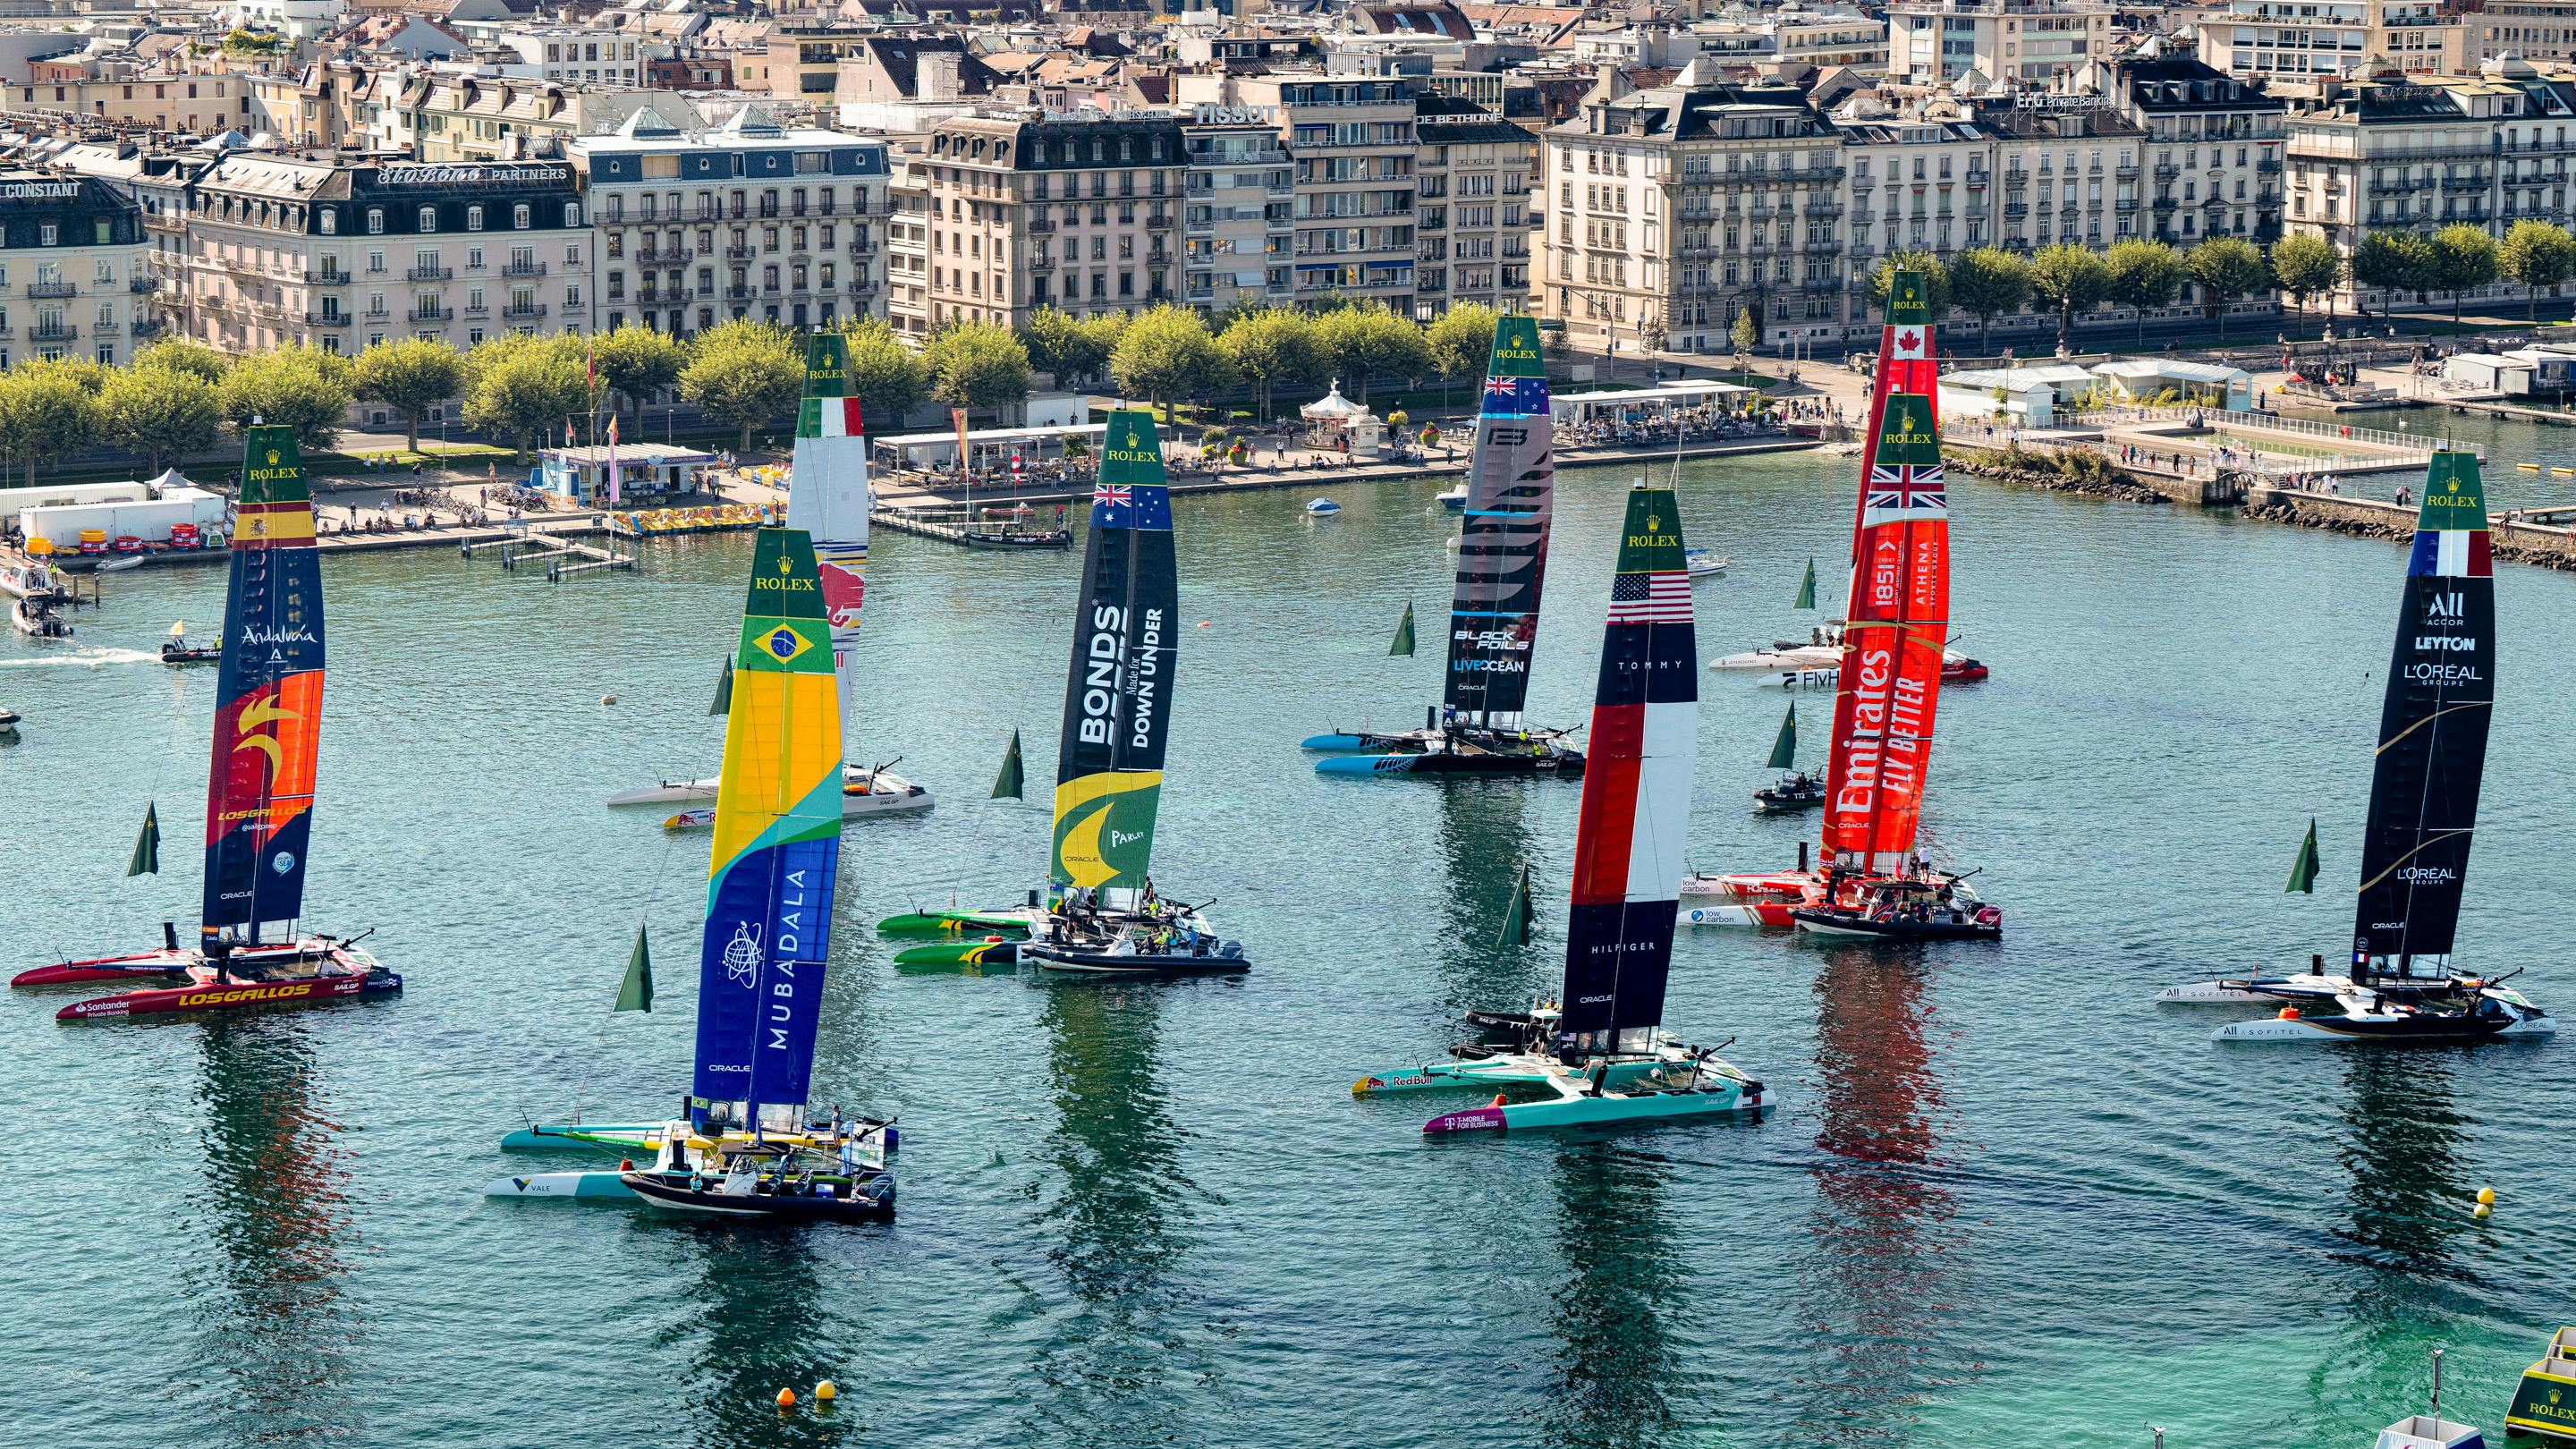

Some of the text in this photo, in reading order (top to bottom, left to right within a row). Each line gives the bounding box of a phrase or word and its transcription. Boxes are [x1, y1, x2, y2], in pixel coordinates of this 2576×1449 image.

[2047, 96, 2079, 106] Private
[2080, 94, 2114, 107] Banking
[1193, 106, 1279, 124] TISSOT
[492, 168, 567, 181] PARTNERS
[5, 182, 79, 199] CONSTANT
[1894, 301, 1926, 309] ROLEX
[1496, 349, 1537, 359] ROLEX
[809, 369, 847, 379] ROLEX
[1885, 434, 1932, 444] ROLEX
[1108, 450, 1157, 462] ROLEX
[250, 468, 298, 480] ROLEX
[2427, 496, 2477, 507] ROLEX
[1629, 535, 1678, 547] ROLEX
[1915, 541, 1929, 606] ATHENA
[755, 577, 815, 591] ROLEX
[242, 623, 318, 645] Andalucía
[1454, 631, 1517, 641] BLACK
[1477, 640, 1530, 650] FOILS
[2415, 636, 2476, 651] LEYTON
[1618, 660, 1682, 671] TOMMY
[1080, 605, 1120, 745] BONDS
[1125, 656, 1140, 696] Made for
[1132, 608, 1163, 749] DOWN UNDER
[2422, 680, 2464, 688] GROUPE
[1835, 649, 1891, 814] Emirates
[1882, 677, 1926, 794] FLY BETTER
[217, 806, 308, 821] LOSGALLOS
[221, 891, 253, 900] ORACLE
[1591, 942, 1655, 954] HILFIGER
[767, 869, 806, 1050] MUBADALA
[178, 984, 312, 1006] LOSGALLOS
[1580, 995, 1613, 1004] ORACLE
[87, 1001, 131, 1012] Santander
[87, 1009, 130, 1018] Private Banking
[709, 1063, 751, 1072] ORACLE
[1394, 1075, 1432, 1086] Red Bull
[1457, 1115, 1486, 1123] T-MOBILE
[1470, 1120, 1498, 1129] BUSINESS
[2529, 1402, 2576, 1421] ROLEX
